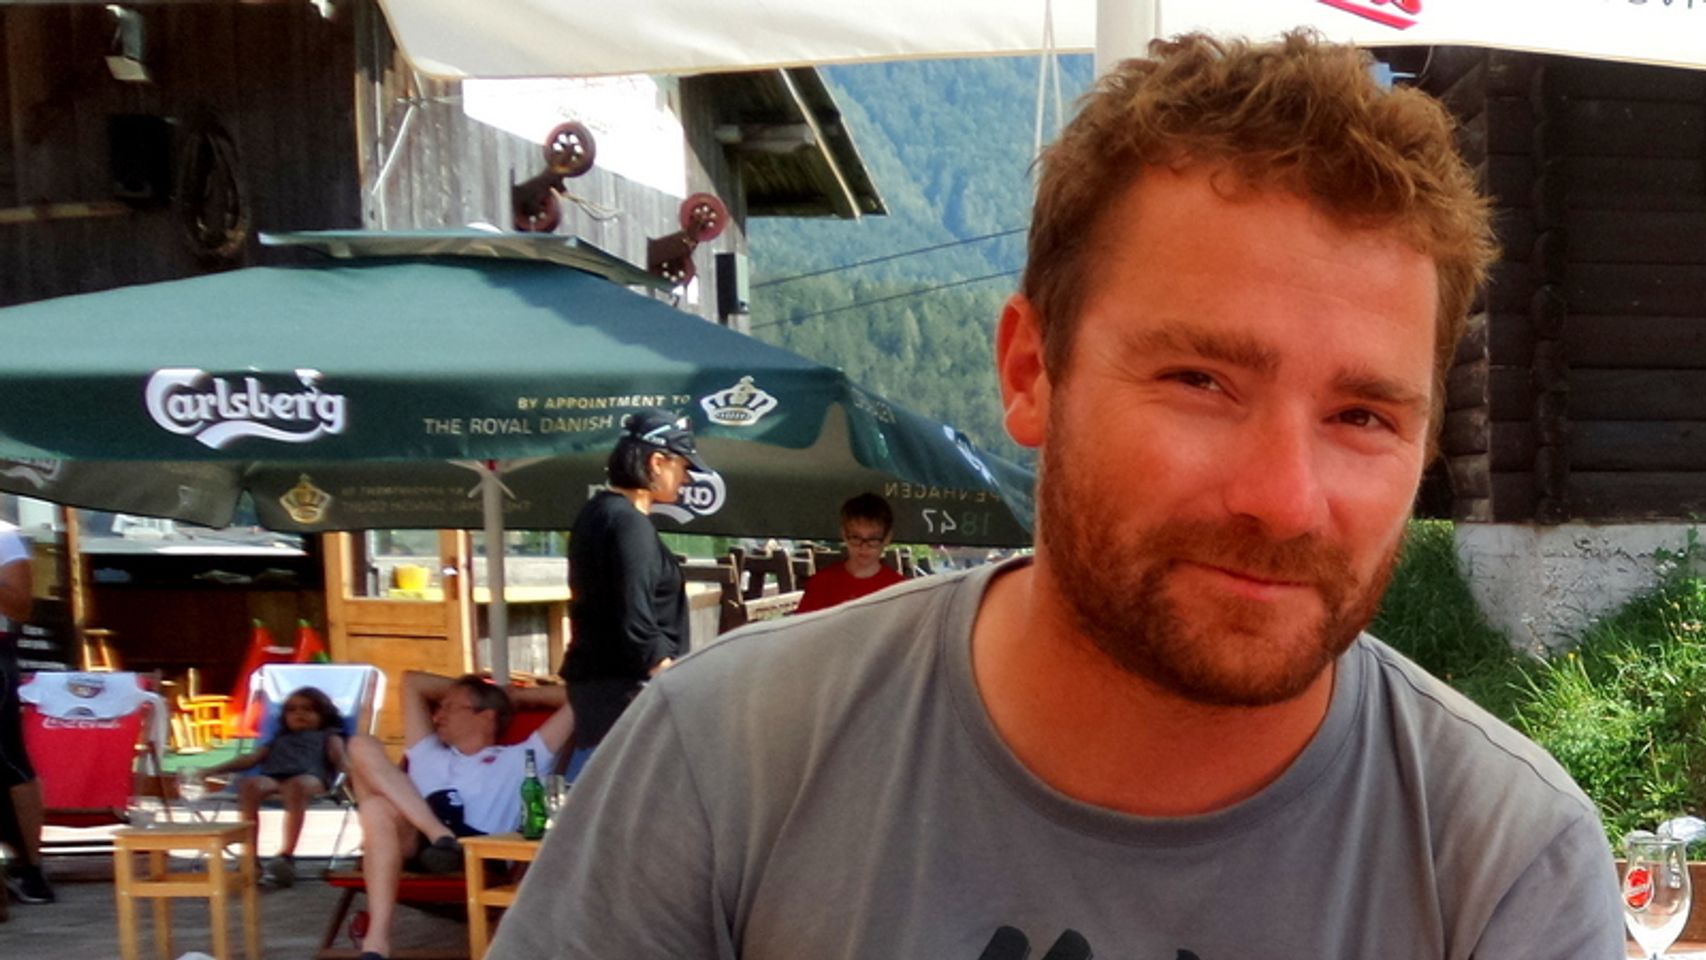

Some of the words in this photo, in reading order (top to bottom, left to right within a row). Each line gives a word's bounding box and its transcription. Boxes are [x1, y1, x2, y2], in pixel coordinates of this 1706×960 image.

[145, 366, 347, 449] Carlsberg
[517, 396, 538, 410] BY
[544, 395, 666, 409] APPOINTMENT
[671, 394, 691, 405] TO
[422, 418, 462, 435] THE
[469, 417, 532, 435] ROYAL
[539, 414, 613, 434] DANISH
